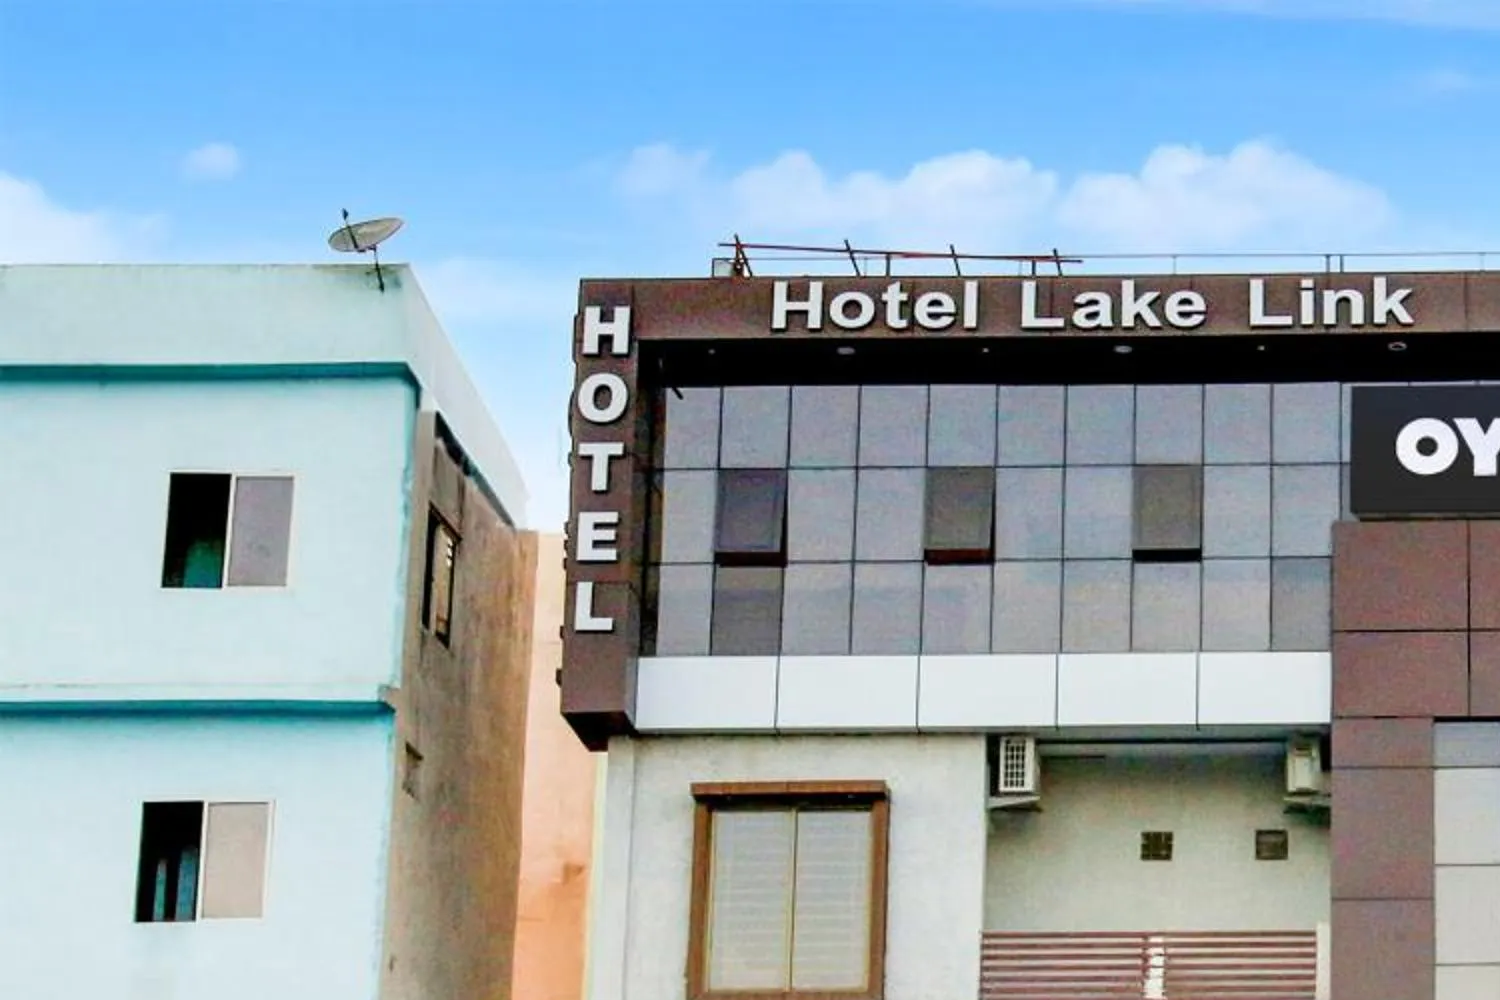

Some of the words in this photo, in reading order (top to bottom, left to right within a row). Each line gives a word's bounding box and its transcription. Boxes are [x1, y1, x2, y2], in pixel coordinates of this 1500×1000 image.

[770, 279, 979, 331] Hotel
[1019, 278, 1207, 330] Lake
[1246, 275, 1415, 328] Link
[573, 304, 632, 635] HOTEL
